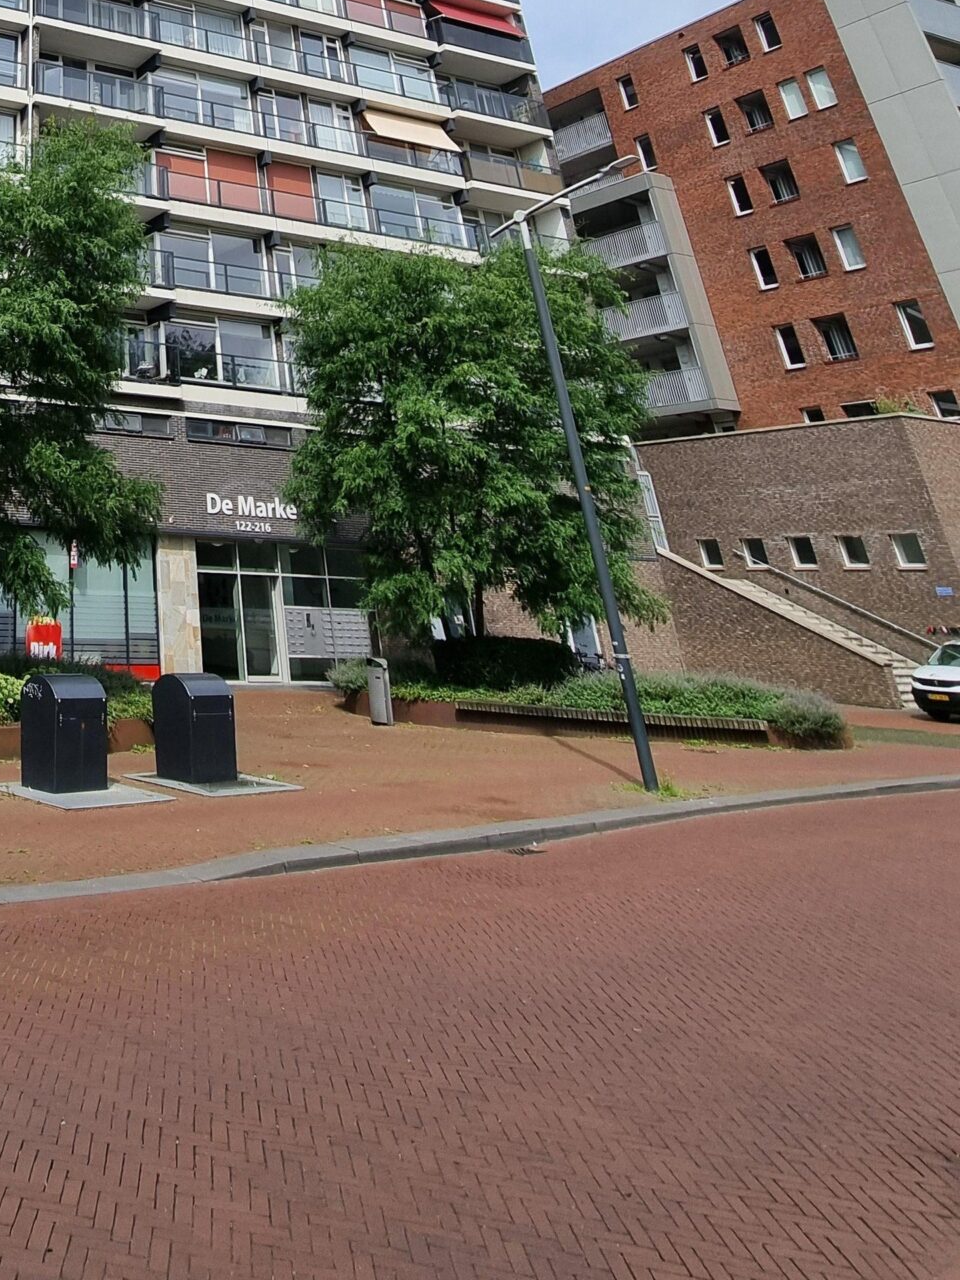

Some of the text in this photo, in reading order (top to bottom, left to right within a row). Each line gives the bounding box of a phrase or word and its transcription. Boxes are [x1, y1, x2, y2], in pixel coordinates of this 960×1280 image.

[206, 493, 297, 520] De Marke
[235, 521, 271, 533] 122-216
[31, 641, 56, 660] Dirk
